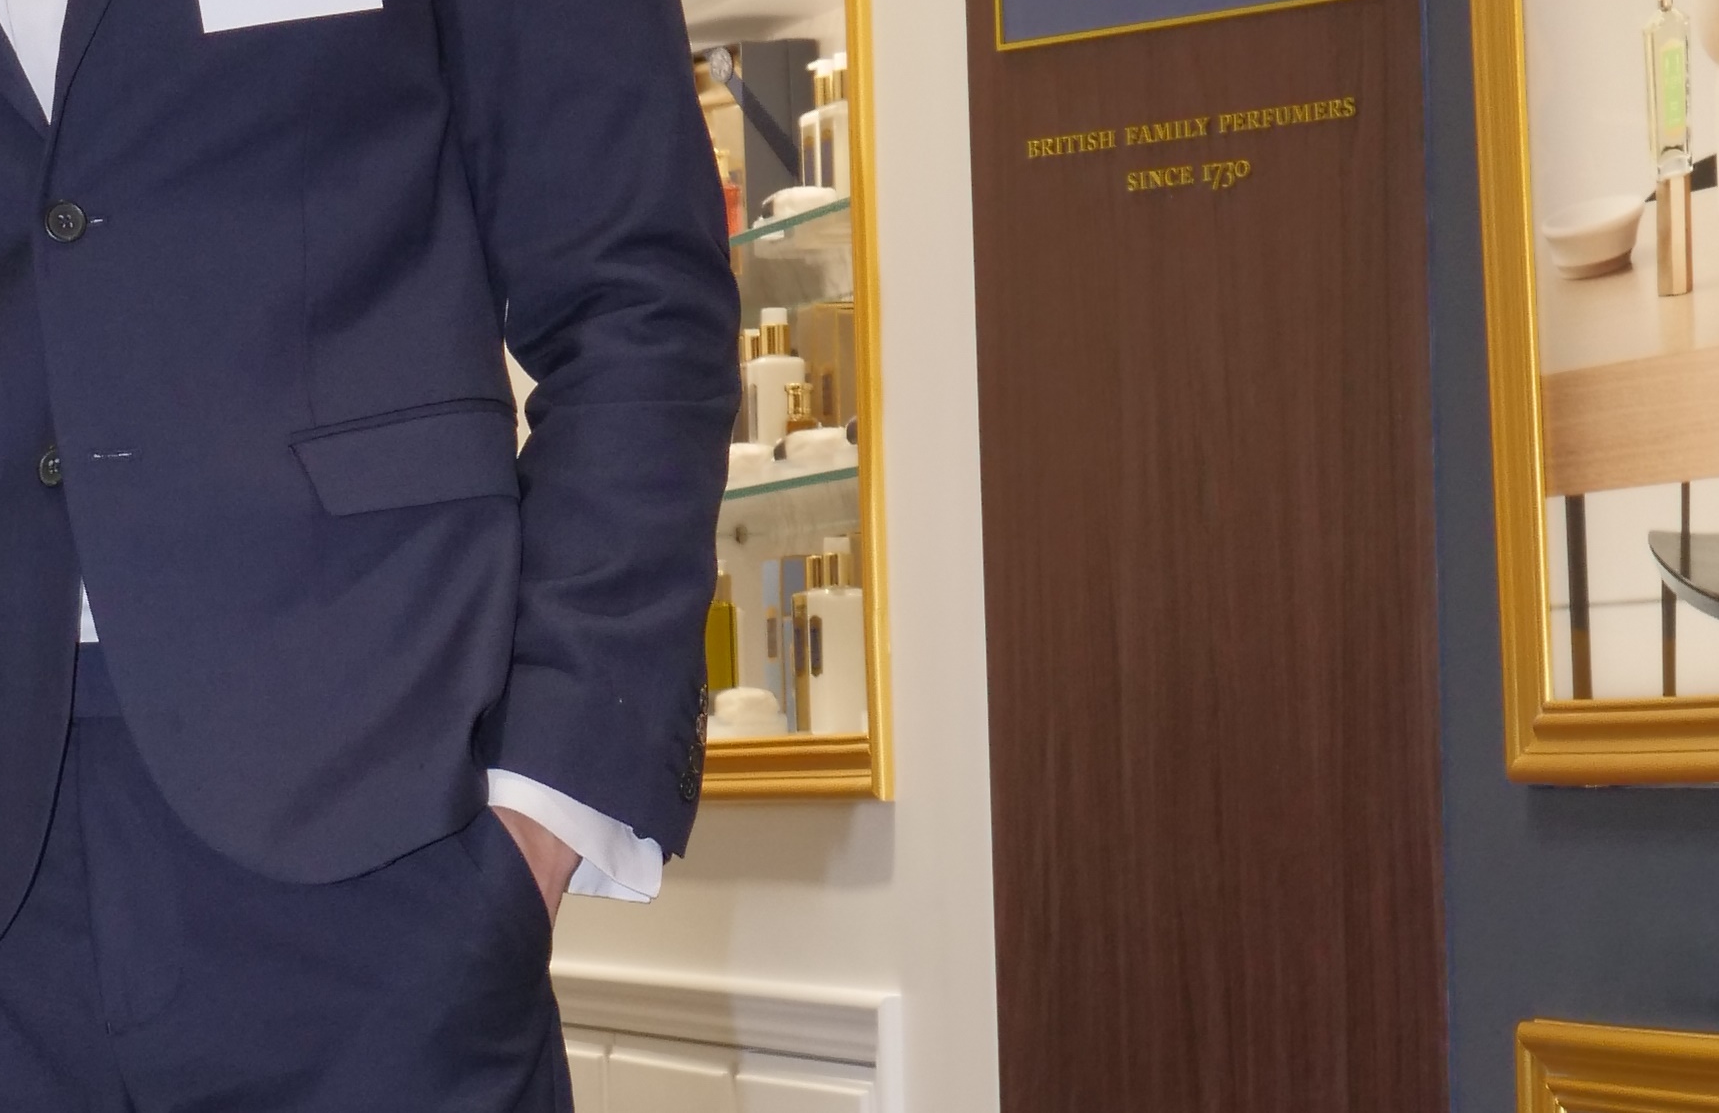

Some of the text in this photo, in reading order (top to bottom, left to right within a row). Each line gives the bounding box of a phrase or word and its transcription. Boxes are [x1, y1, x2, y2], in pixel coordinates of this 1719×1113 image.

[1027, 96, 1357, 159] BRITISH FAMILY PERFUMERS
[1127, 160, 1251, 191] SINCE 1730
